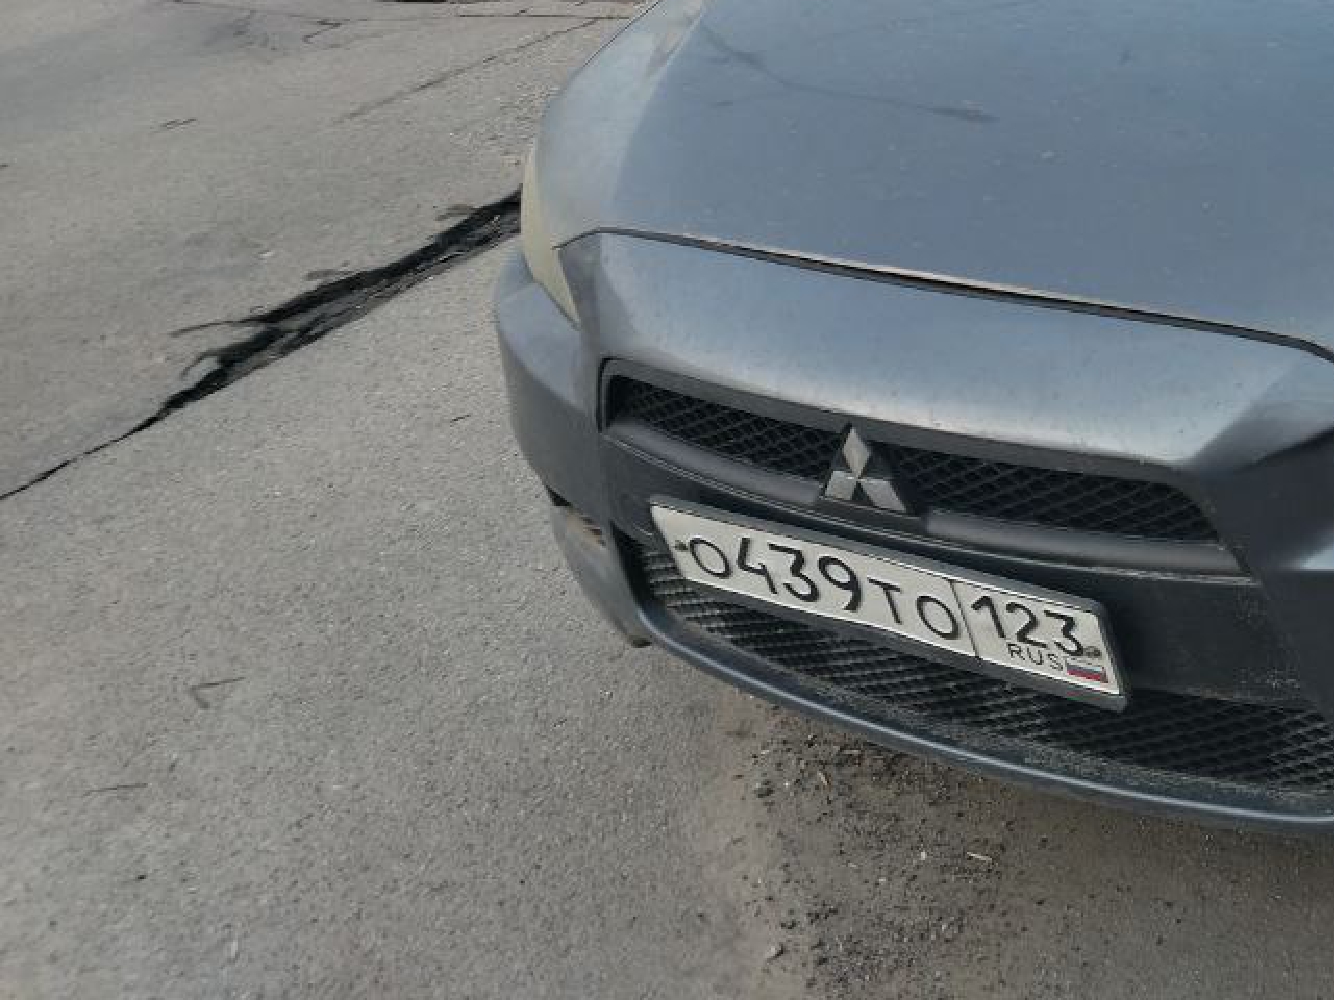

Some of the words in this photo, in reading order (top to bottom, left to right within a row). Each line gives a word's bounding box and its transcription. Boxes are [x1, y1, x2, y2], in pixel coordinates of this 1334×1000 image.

[689, 537, 960, 640] О439ТО
[971, 595, 1085, 657] 123
[1007, 642, 1064, 672] RUS
